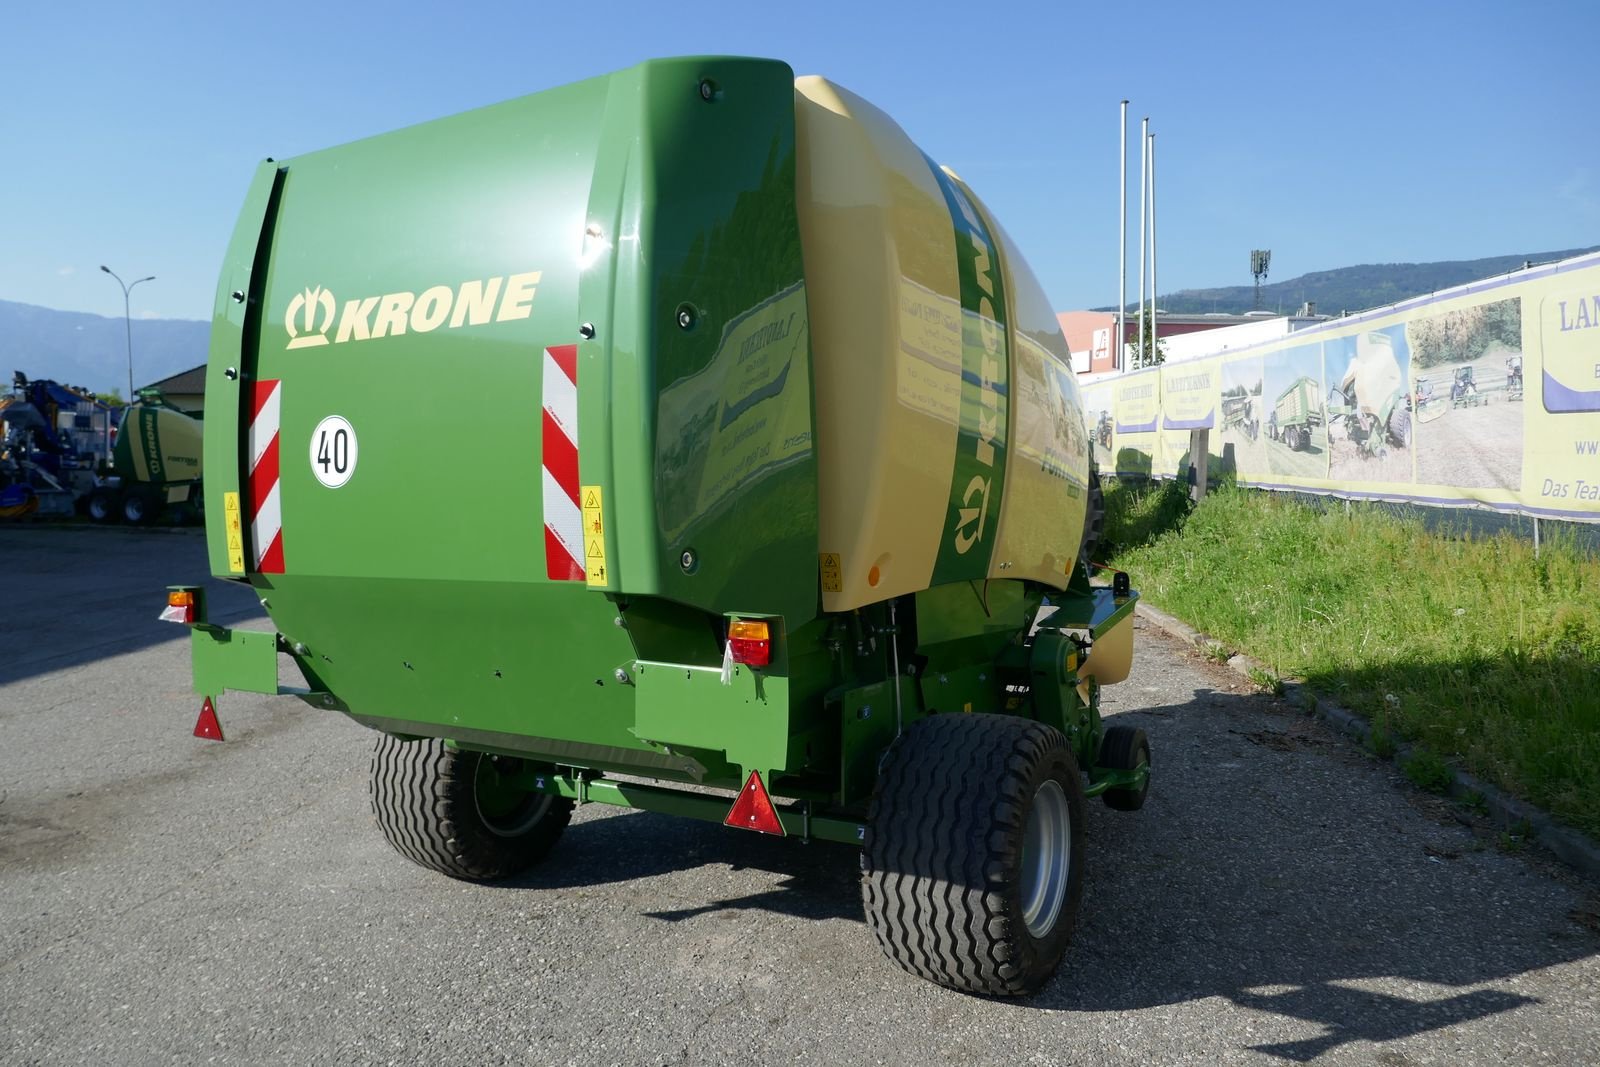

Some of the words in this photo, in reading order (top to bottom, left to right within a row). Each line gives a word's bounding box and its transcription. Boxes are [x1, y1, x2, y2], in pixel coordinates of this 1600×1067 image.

[335, 271, 542, 343] KRONE
[317, 428, 348, 474] 40
[1541, 478, 1569, 498] Das
[1574, 480, 1600, 500] Tea
